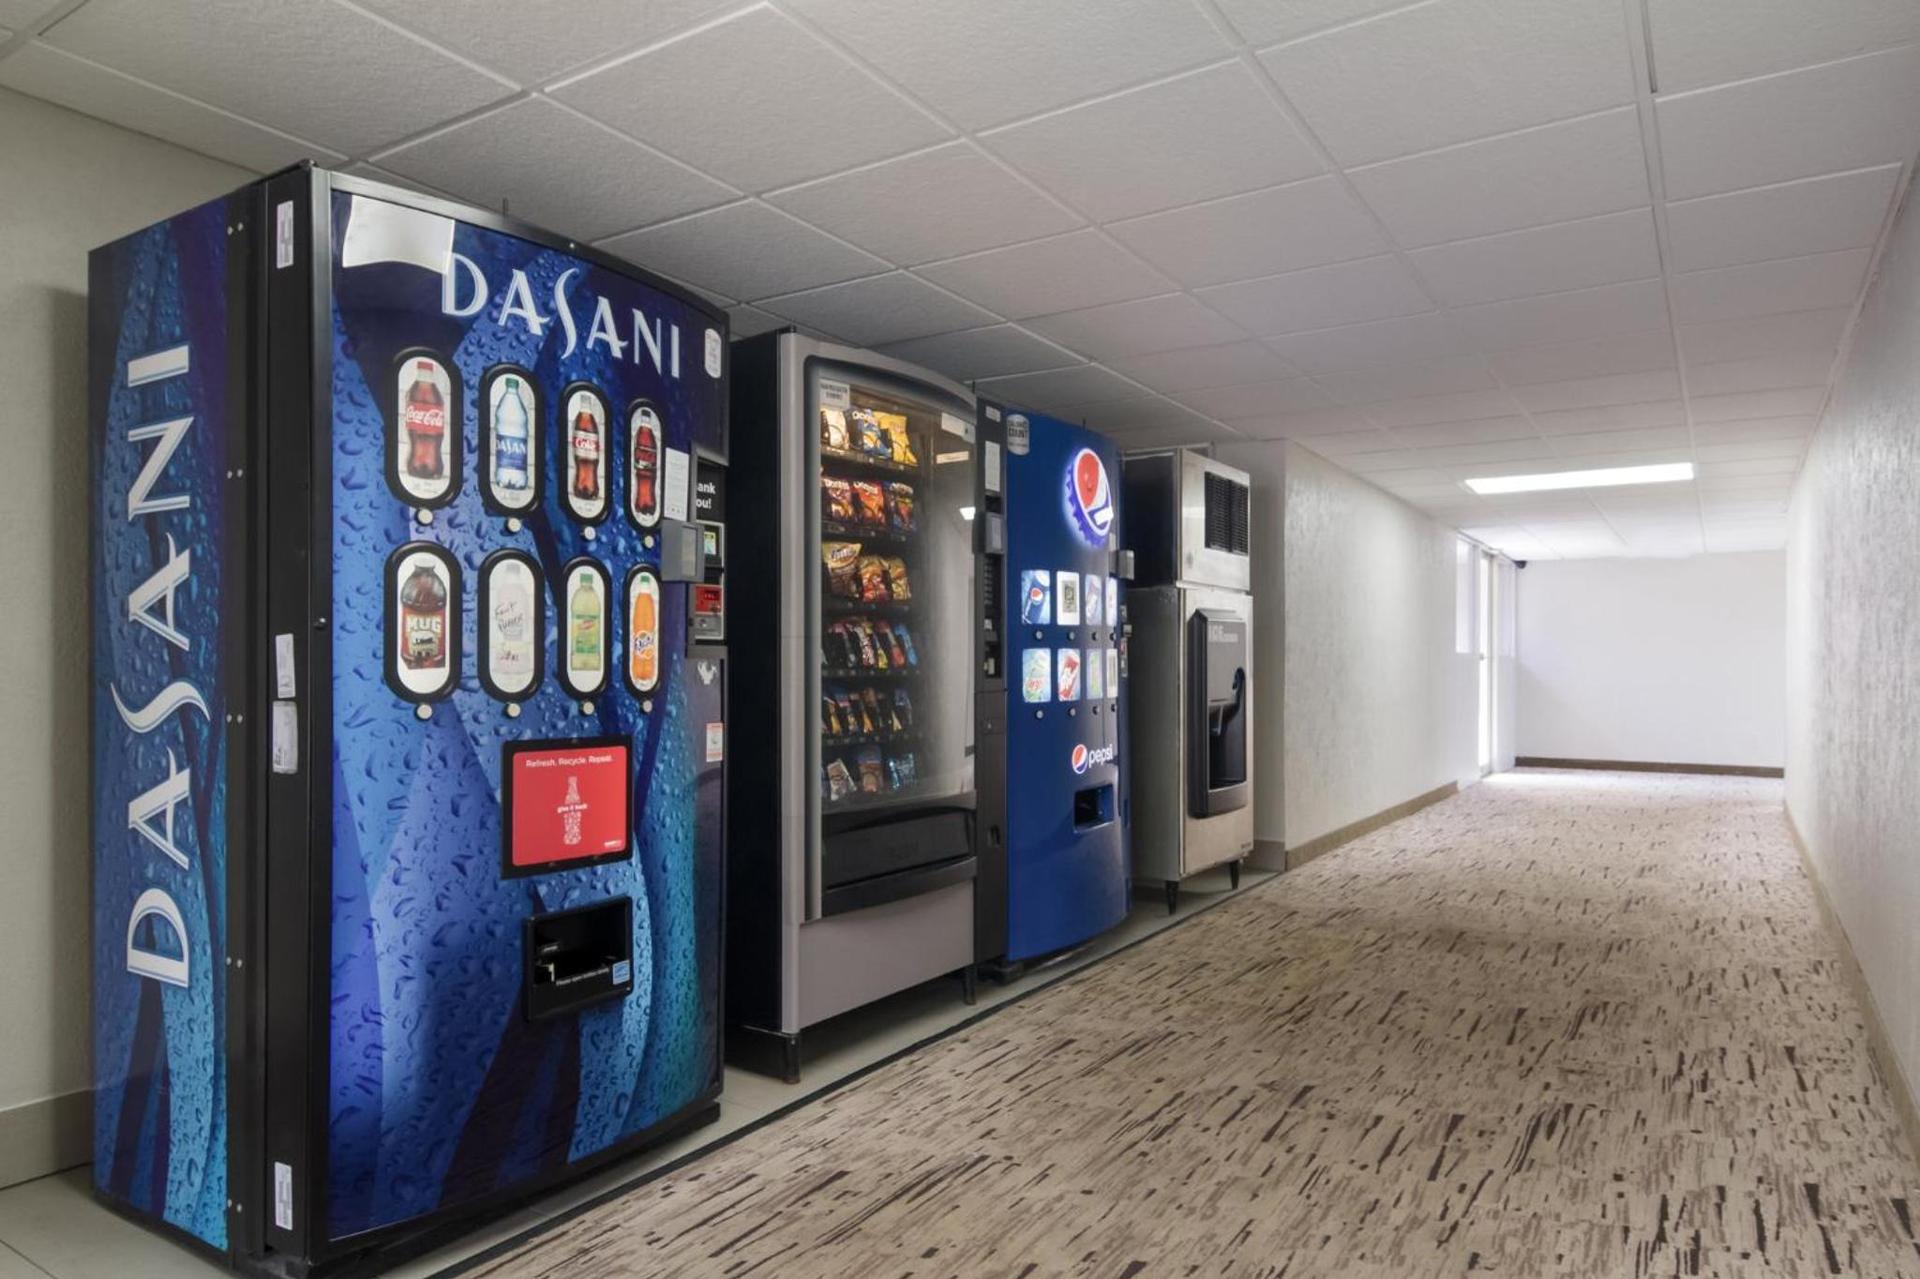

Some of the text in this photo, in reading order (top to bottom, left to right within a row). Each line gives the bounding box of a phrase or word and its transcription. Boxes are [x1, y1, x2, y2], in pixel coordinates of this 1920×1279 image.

[441, 252, 681, 379] DASANI
[697, 481, 716, 495] ank
[696, 498, 712, 509] ou!
[405, 614, 442, 633] MUG
[110, 343, 211, 989] DASANI
[1088, 743, 1113, 769] pepsi
